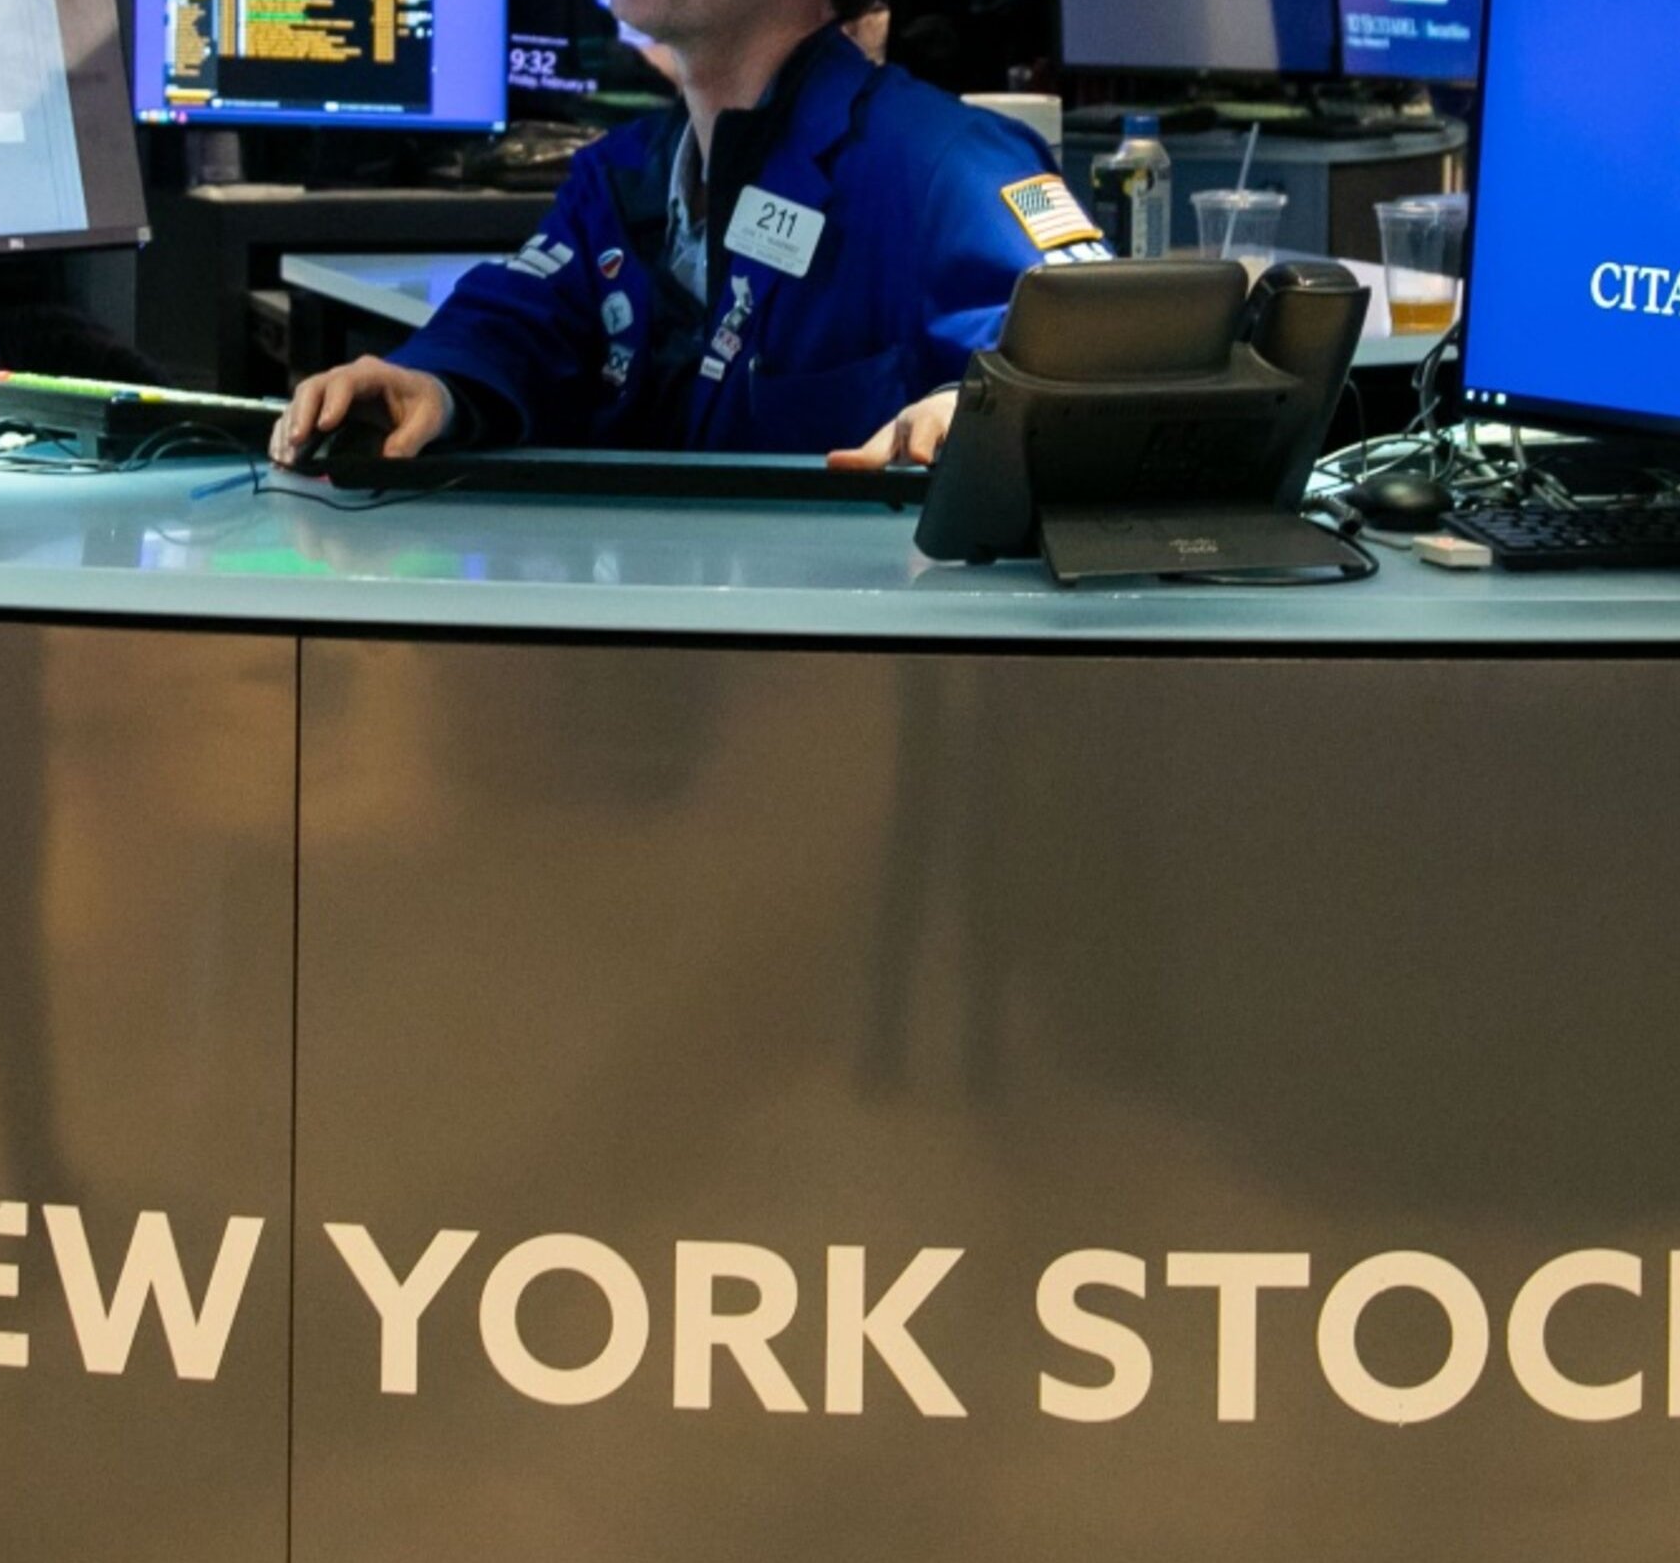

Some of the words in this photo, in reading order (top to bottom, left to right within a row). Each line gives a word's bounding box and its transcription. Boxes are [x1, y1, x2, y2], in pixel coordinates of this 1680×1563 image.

[510, 48, 556, 75] 9:32
[757, 202, 798, 238] 211
[324, 1223, 967, 1418] YORK
